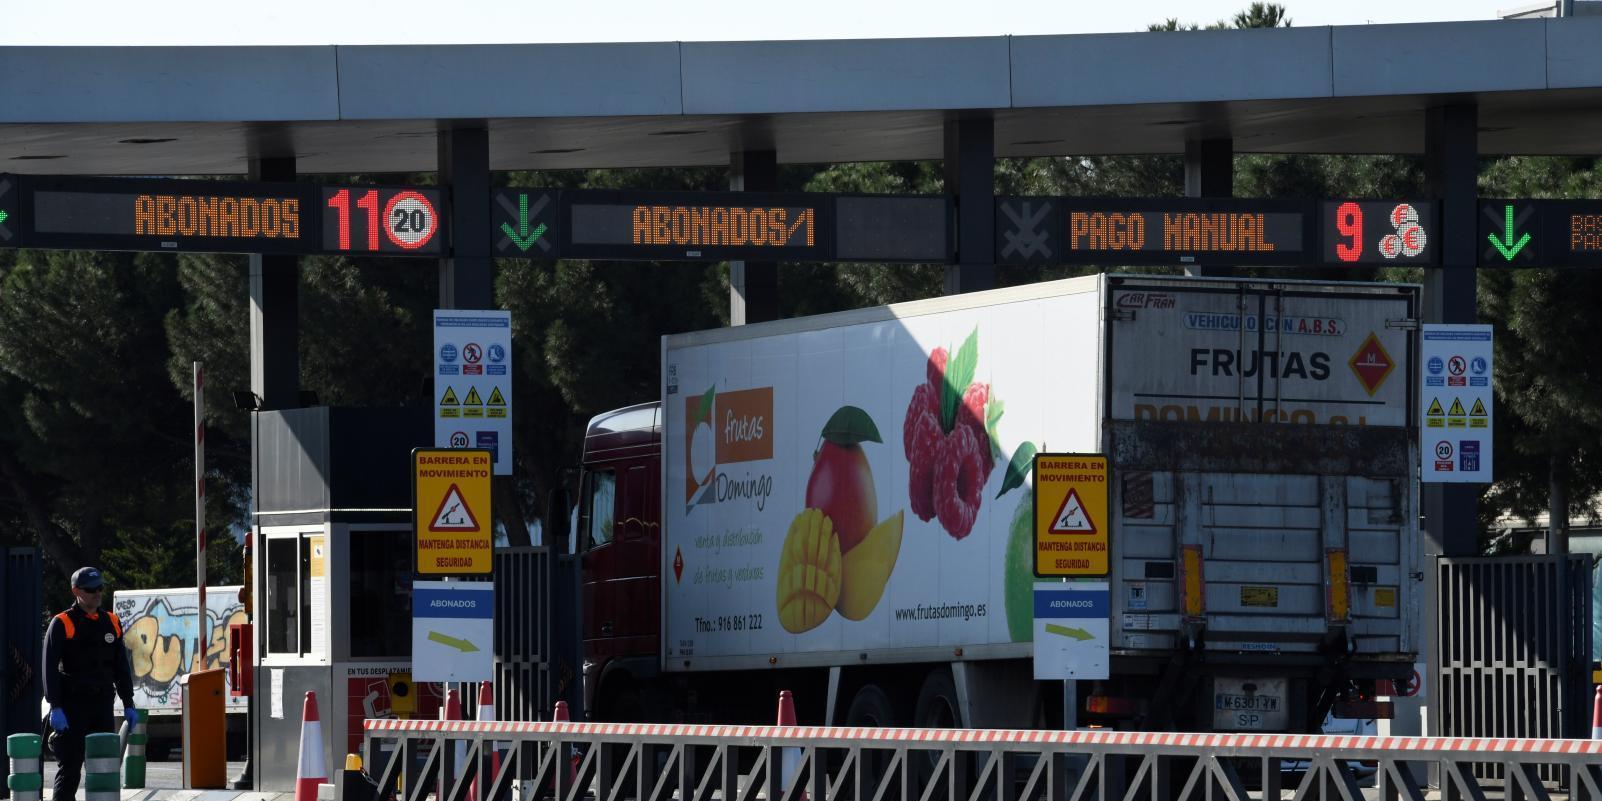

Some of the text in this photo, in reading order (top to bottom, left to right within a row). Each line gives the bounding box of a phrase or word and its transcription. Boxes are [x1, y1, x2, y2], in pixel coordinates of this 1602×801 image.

[135, 194, 299, 238] ABONADOS
[328, 189, 379, 251] 11
[394, 208, 426, 233] 20
[632, 205, 815, 247] ABONADOS/1
[1070, 212, 1274, 252] PAGO MANUAL
[1336, 202, 1364, 262] 9
[1298, 319, 1341, 334] A.B.S.
[1190, 348, 1331, 381] FRUTAS
[725, 409, 764, 444] frutas
[1438, 446, 1449, 455] 20
[419, 456, 488, 465] BARRERA EN
[1040, 462, 1104, 470] BARRERA EN
[419, 469, 488, 478] MOVIMIENTO
[1040, 474, 1105, 482] MOVIMIENTO
[716, 471, 772, 511] Domingo
[419, 539, 490, 550] MANTENGA DISTANCIA
[1039, 541, 1106, 552] MANTENGA DISTANCIA
[436, 557, 472, 568] SEGURIDAD
[1055, 559, 1090, 569] SEGURIDAD
[430, 599, 476, 608] ABONADOS
[1050, 600, 1093, 608] ABONADOS
[895, 601, 987, 621] www.frutasdomingo.es
[695, 614, 763, 632] Tfno.: 916 861 222
[357, 667, 368, 675] TUS
